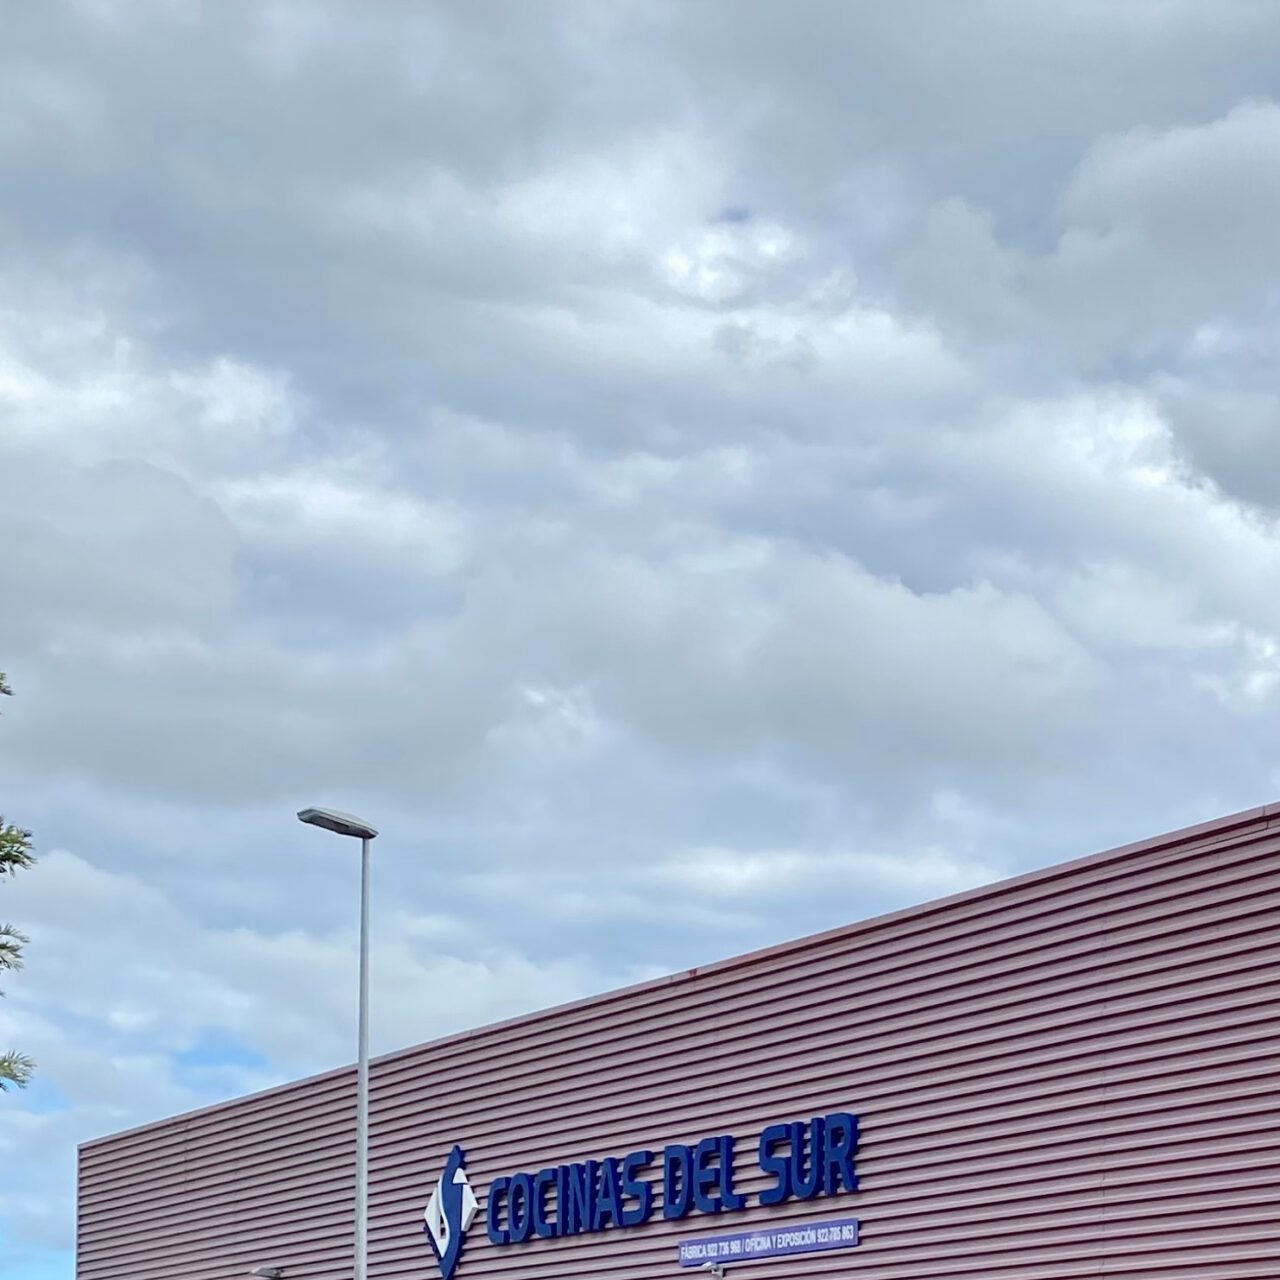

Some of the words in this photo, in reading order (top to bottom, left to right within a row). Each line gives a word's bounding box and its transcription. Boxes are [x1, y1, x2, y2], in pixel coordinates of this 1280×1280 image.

[487, 1150, 653, 1245] COCINAS
[664, 1135, 744, 1221] DEL
[759, 1112, 858, 1206] SUR
[681, 1243, 707, 1259] FÁBRICA
[745, 1236, 771, 1252] OFICINA
[777, 1227, 816, 1248] EXPOSICIÓN
